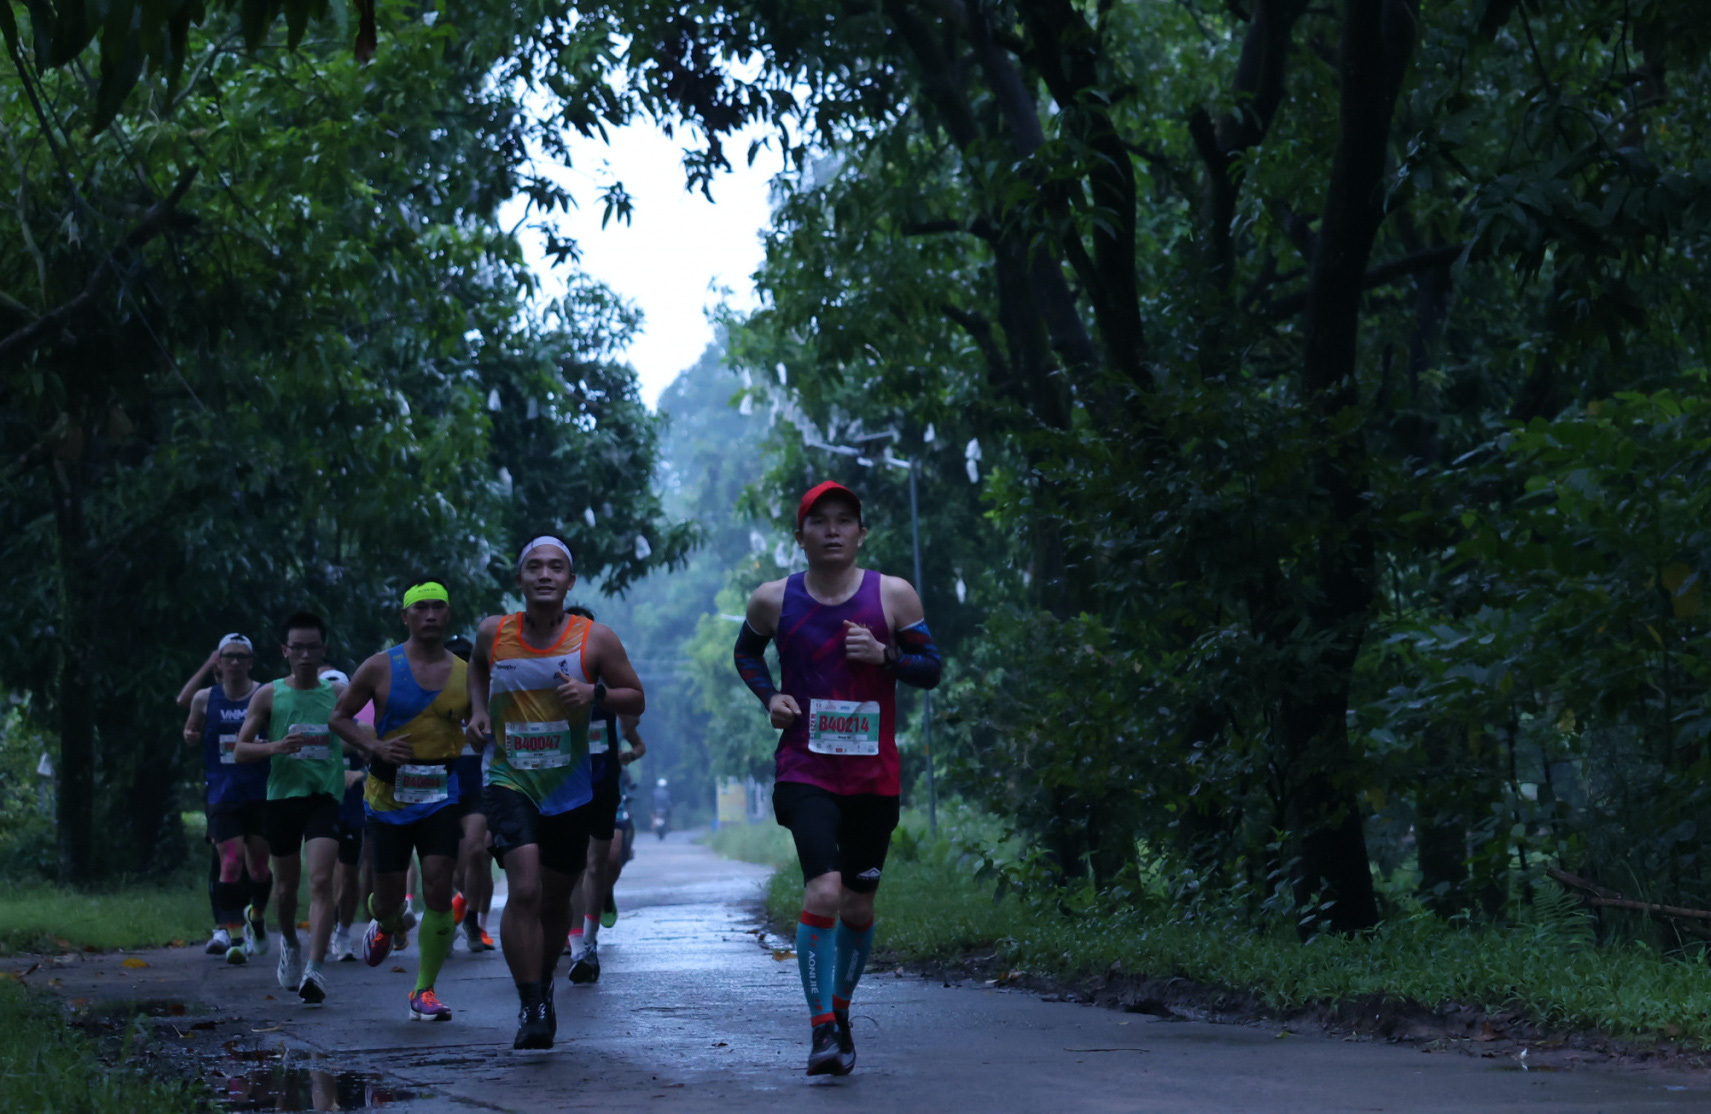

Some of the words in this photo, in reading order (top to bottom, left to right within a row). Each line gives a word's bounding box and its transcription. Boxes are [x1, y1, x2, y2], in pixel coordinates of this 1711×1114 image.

[818, 715, 870, 733] B40214
[514, 734, 561, 751] B40047
[808, 950, 819, 994] AONIJIE
